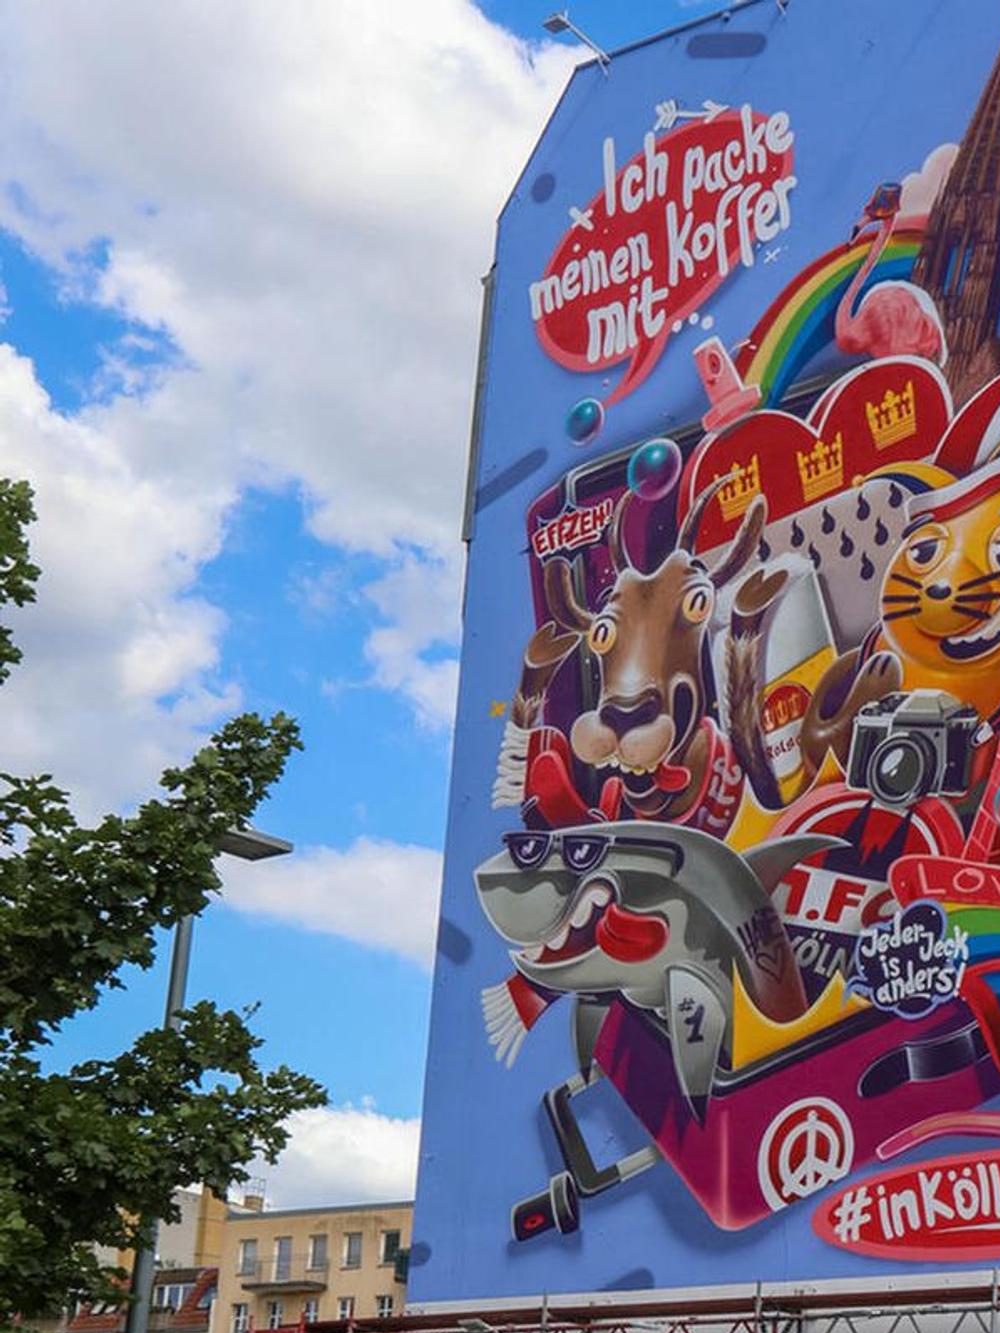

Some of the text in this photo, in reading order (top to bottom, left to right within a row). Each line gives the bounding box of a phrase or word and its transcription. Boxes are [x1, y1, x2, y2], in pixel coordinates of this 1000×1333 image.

[603, 104, 795, 216] Ich packe
[529, 176, 797, 321] meinen Koffer
[861, 910, 970, 962] Jeder Jeck
[879, 954, 901, 980] is
